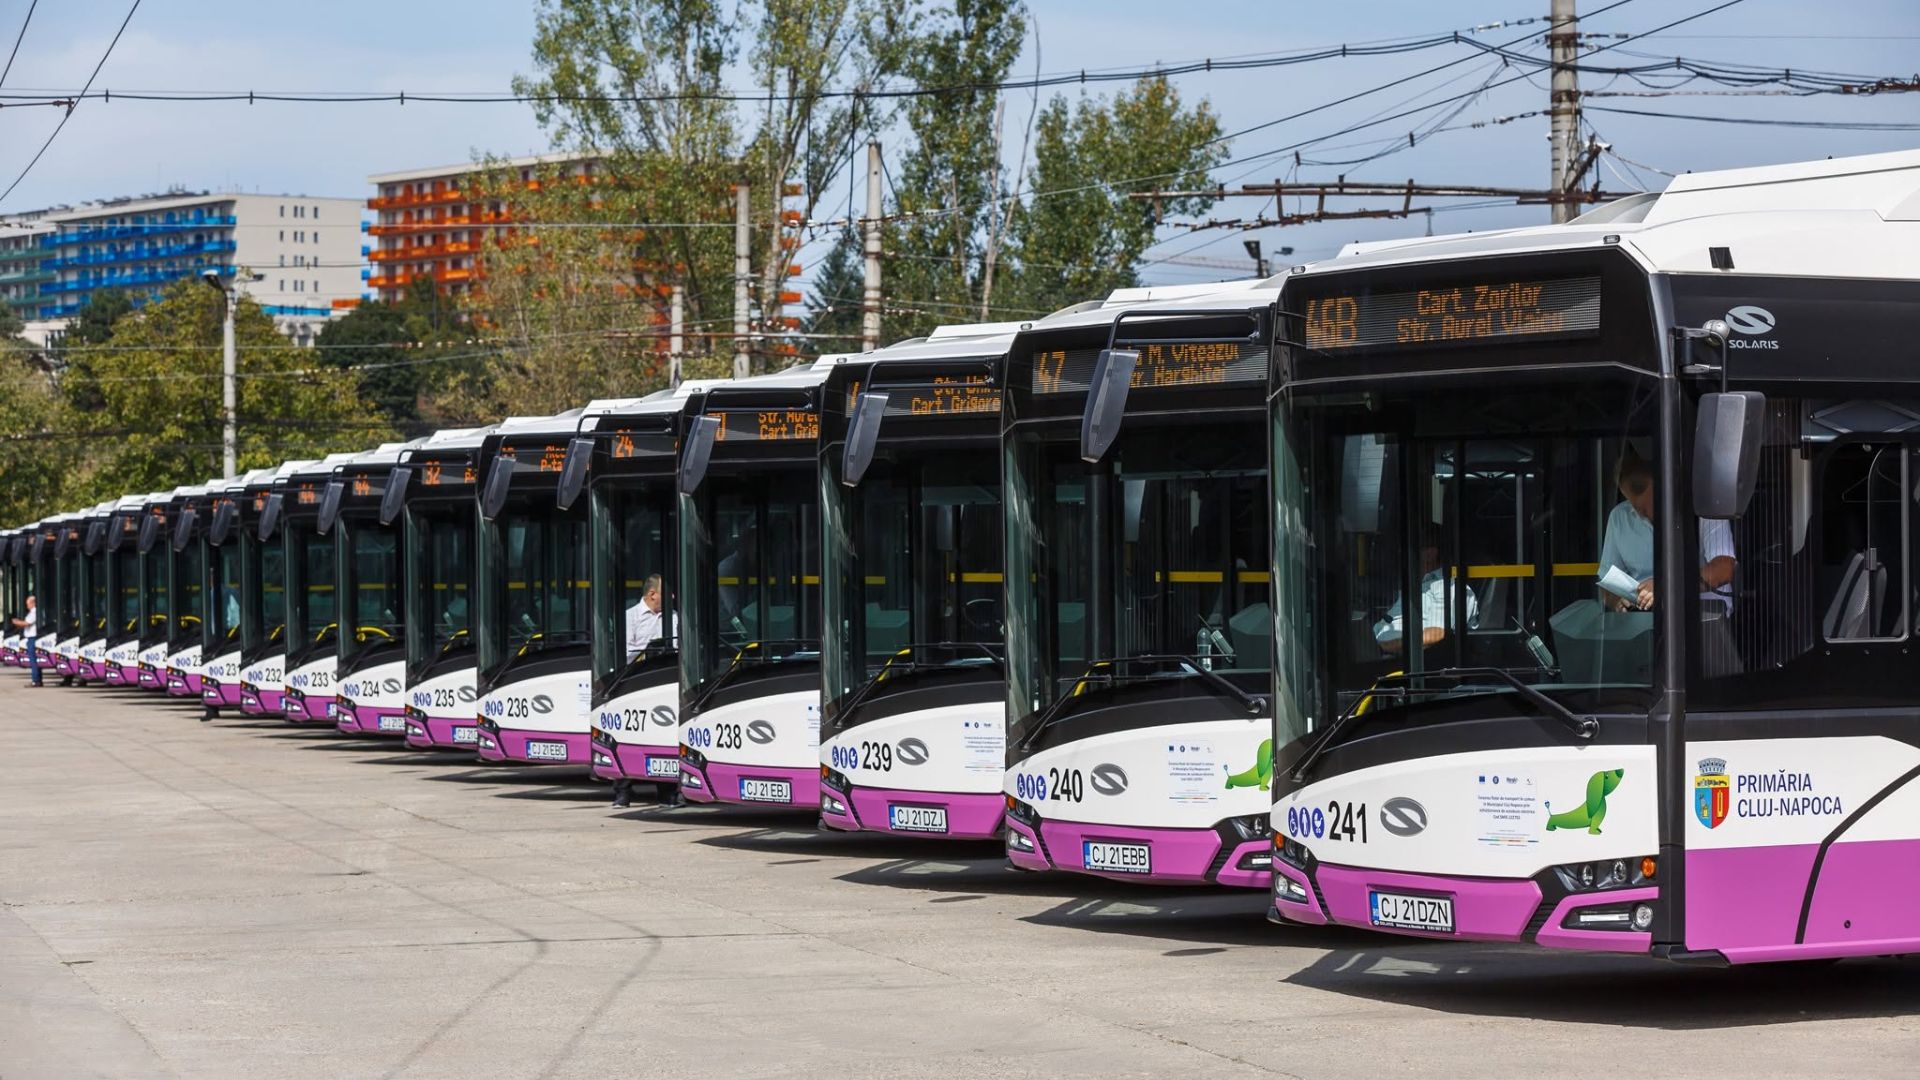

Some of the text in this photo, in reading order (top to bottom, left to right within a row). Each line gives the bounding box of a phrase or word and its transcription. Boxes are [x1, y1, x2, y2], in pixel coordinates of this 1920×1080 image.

[1396, 317, 1434, 343] Str.
[1442, 313, 1493, 339] Aurel
[1728, 339, 1779, 349] SOLARIS
[1037, 351, 1066, 393] 47
[615, 430, 634, 458] 24
[265, 667, 282, 683] 232
[311, 671, 329, 688] 233
[362, 680, 380, 698] 234
[435, 688, 455, 708] 235
[507, 697, 529, 719] 236
[624, 708, 647, 732] 237
[715, 723, 742, 750] 238
[532, 743, 541, 756] CJ
[861, 740, 892, 773] 239
[652, 759, 662, 772] CJ
[746, 781, 757, 796] CJ
[1050, 767, 1083, 803] 240
[1737, 768, 1813, 793] PRIMĂRIA
[897, 808, 909, 825] CJ
[1737, 796, 1843, 818] CLUJ-NAPOCA
[1328, 800, 1368, 844] 241
[1092, 845, 1106, 864] CJ
[1381, 897, 1398, 920] CJ
